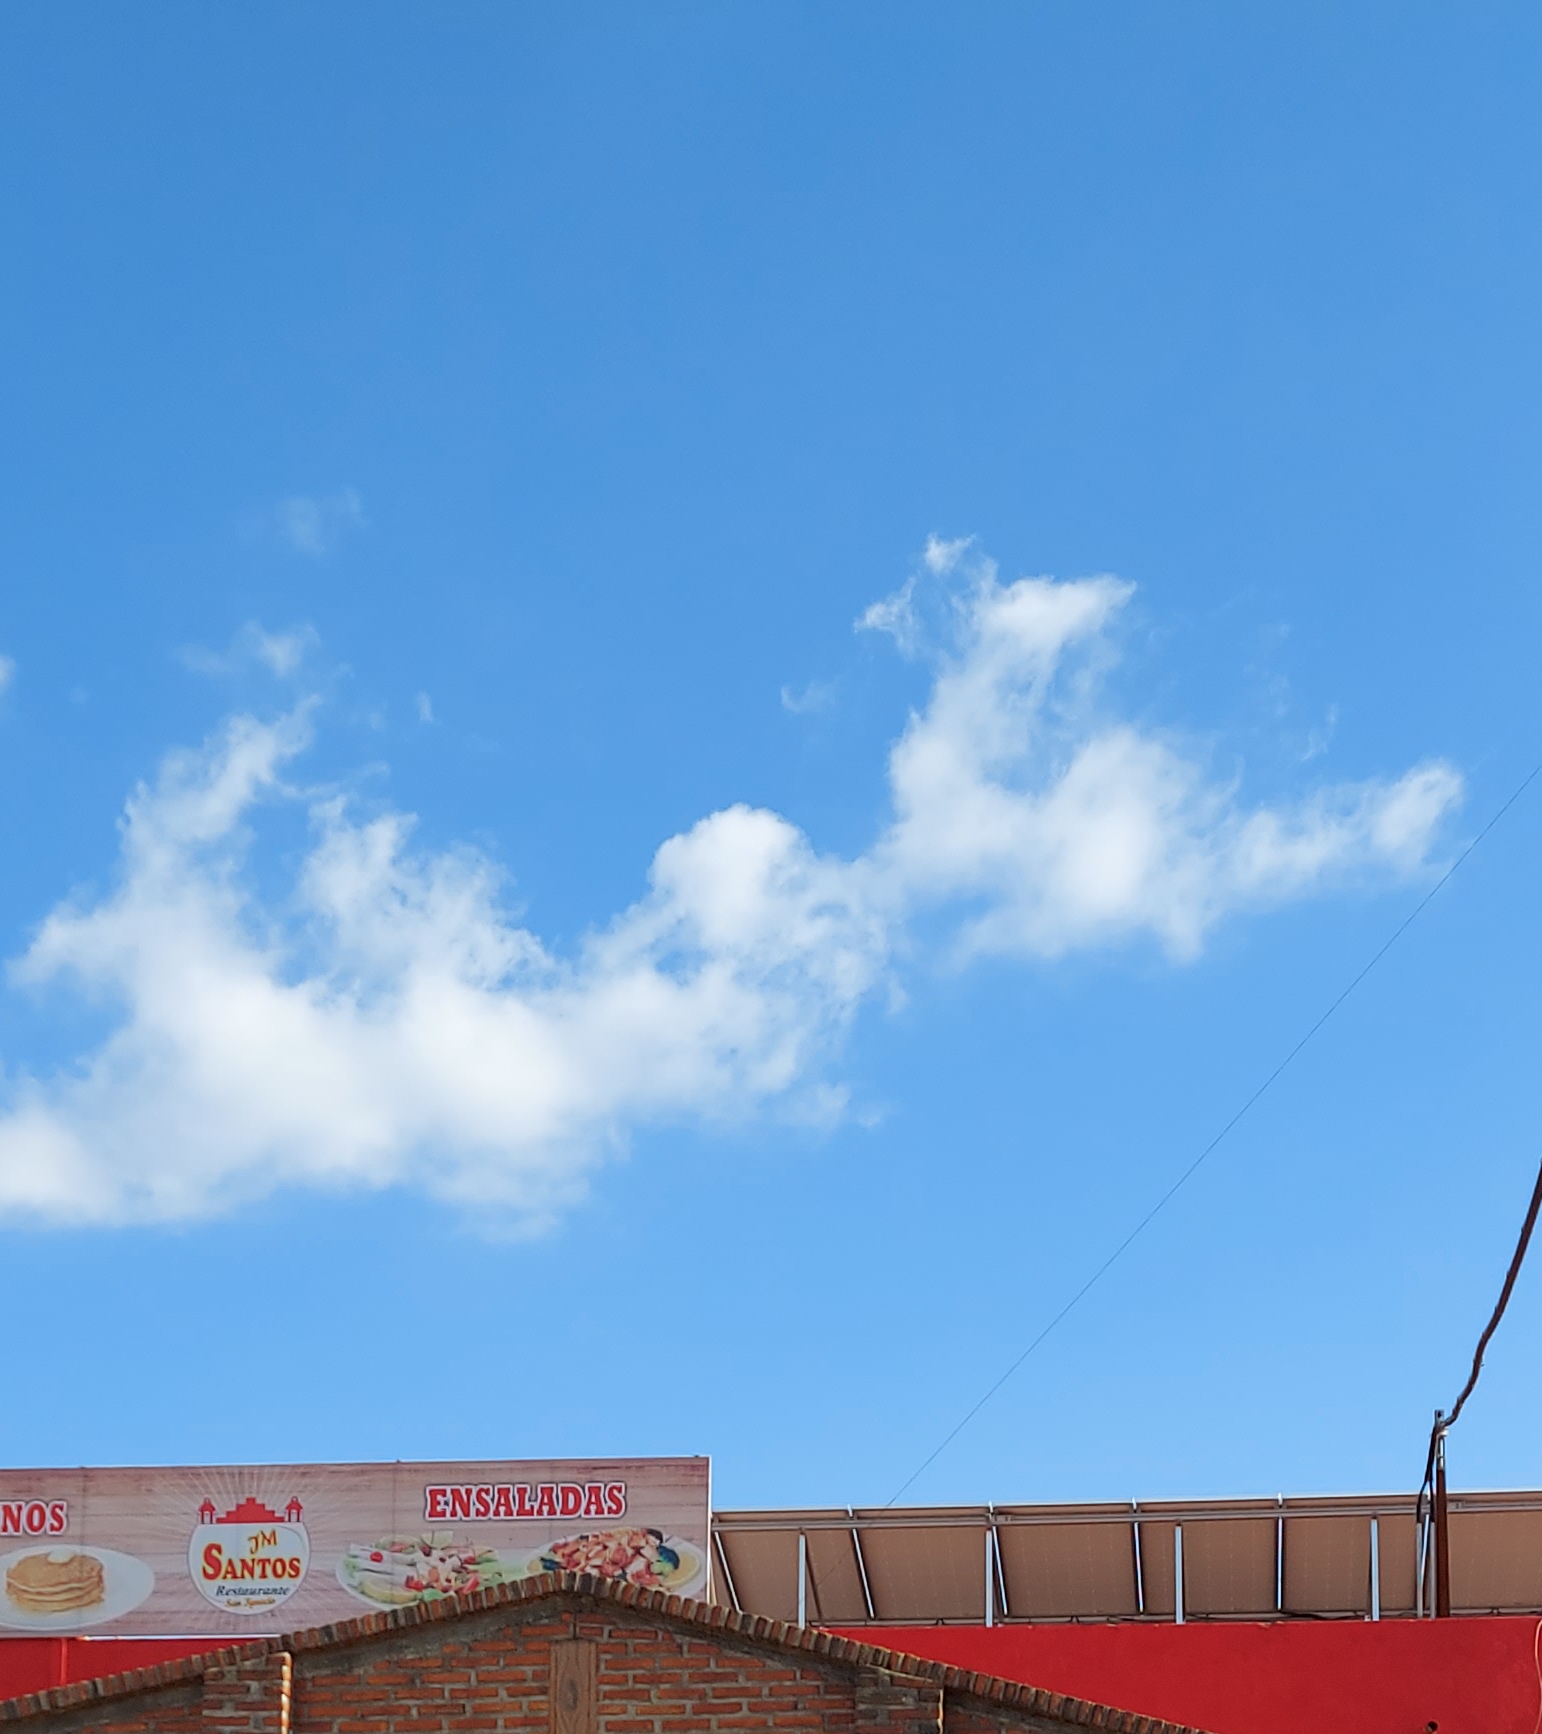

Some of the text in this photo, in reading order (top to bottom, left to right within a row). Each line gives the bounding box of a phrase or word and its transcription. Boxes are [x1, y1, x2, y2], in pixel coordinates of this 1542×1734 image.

[427, 1484, 625, 1519] ENSALADAS
[247, 1529, 278, 1554] JM
[201, 1542, 301, 1581] SANTOS
